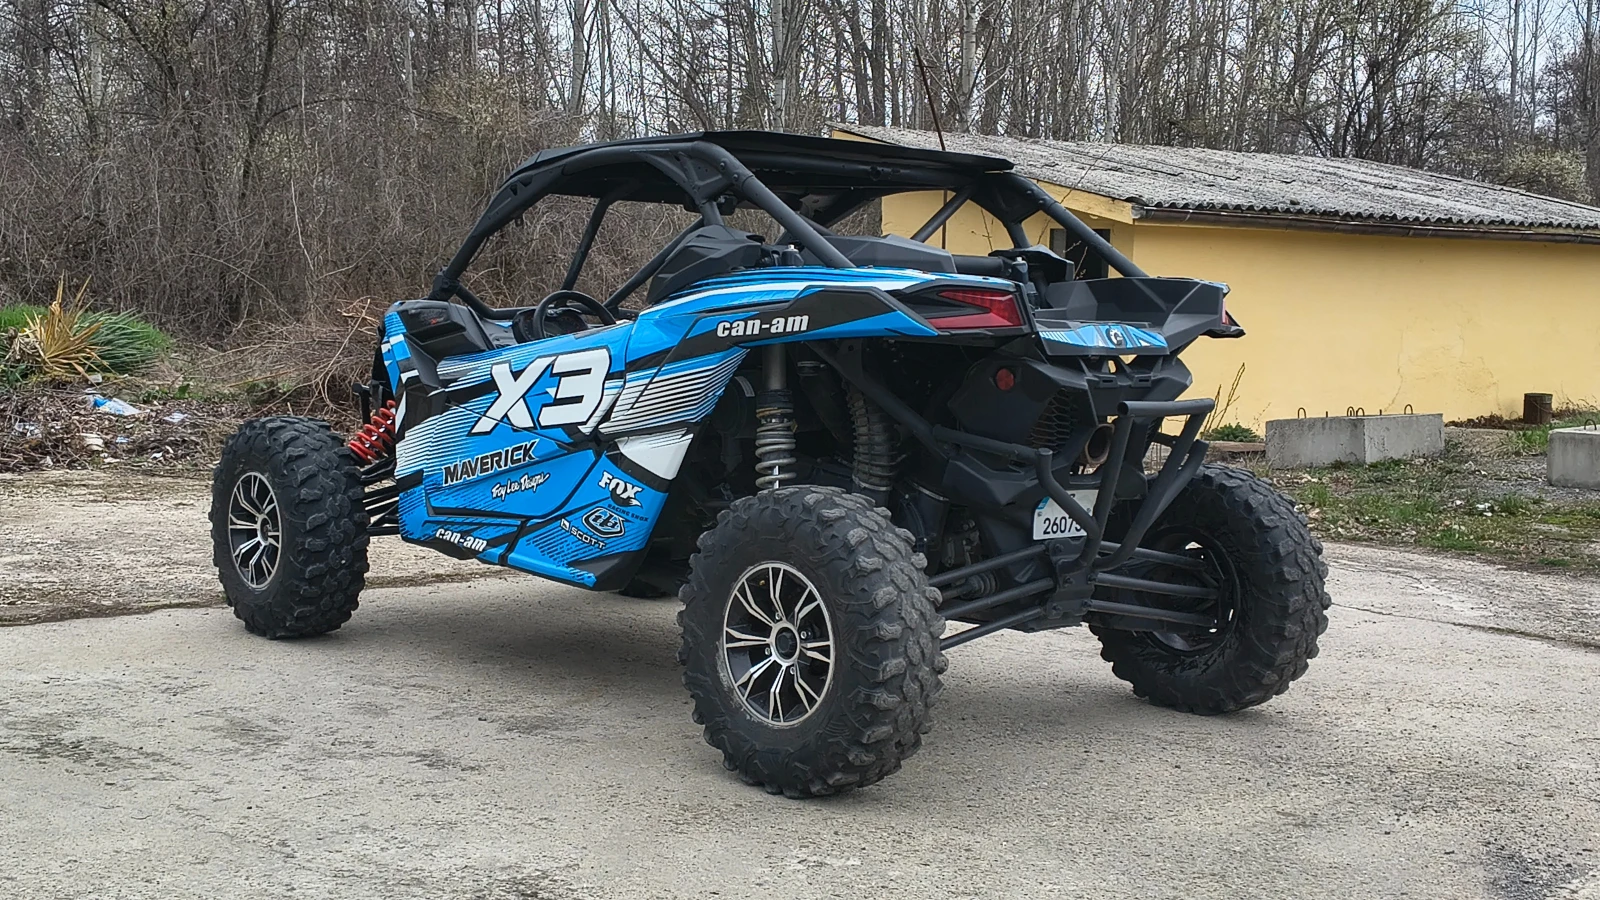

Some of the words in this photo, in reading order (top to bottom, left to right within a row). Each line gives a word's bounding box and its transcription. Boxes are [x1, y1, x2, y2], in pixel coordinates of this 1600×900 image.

[716, 314, 810, 338] can-am
[468, 347, 611, 435] X3
[442, 438, 540, 487] MAVERICK
[492, 483, 507, 500] Troy
[507, 479, 520, 494] Lee
[598, 470, 643, 500] FOX
[435, 528, 488, 552] can-am
[570, 525, 606, 550] SCOTT
